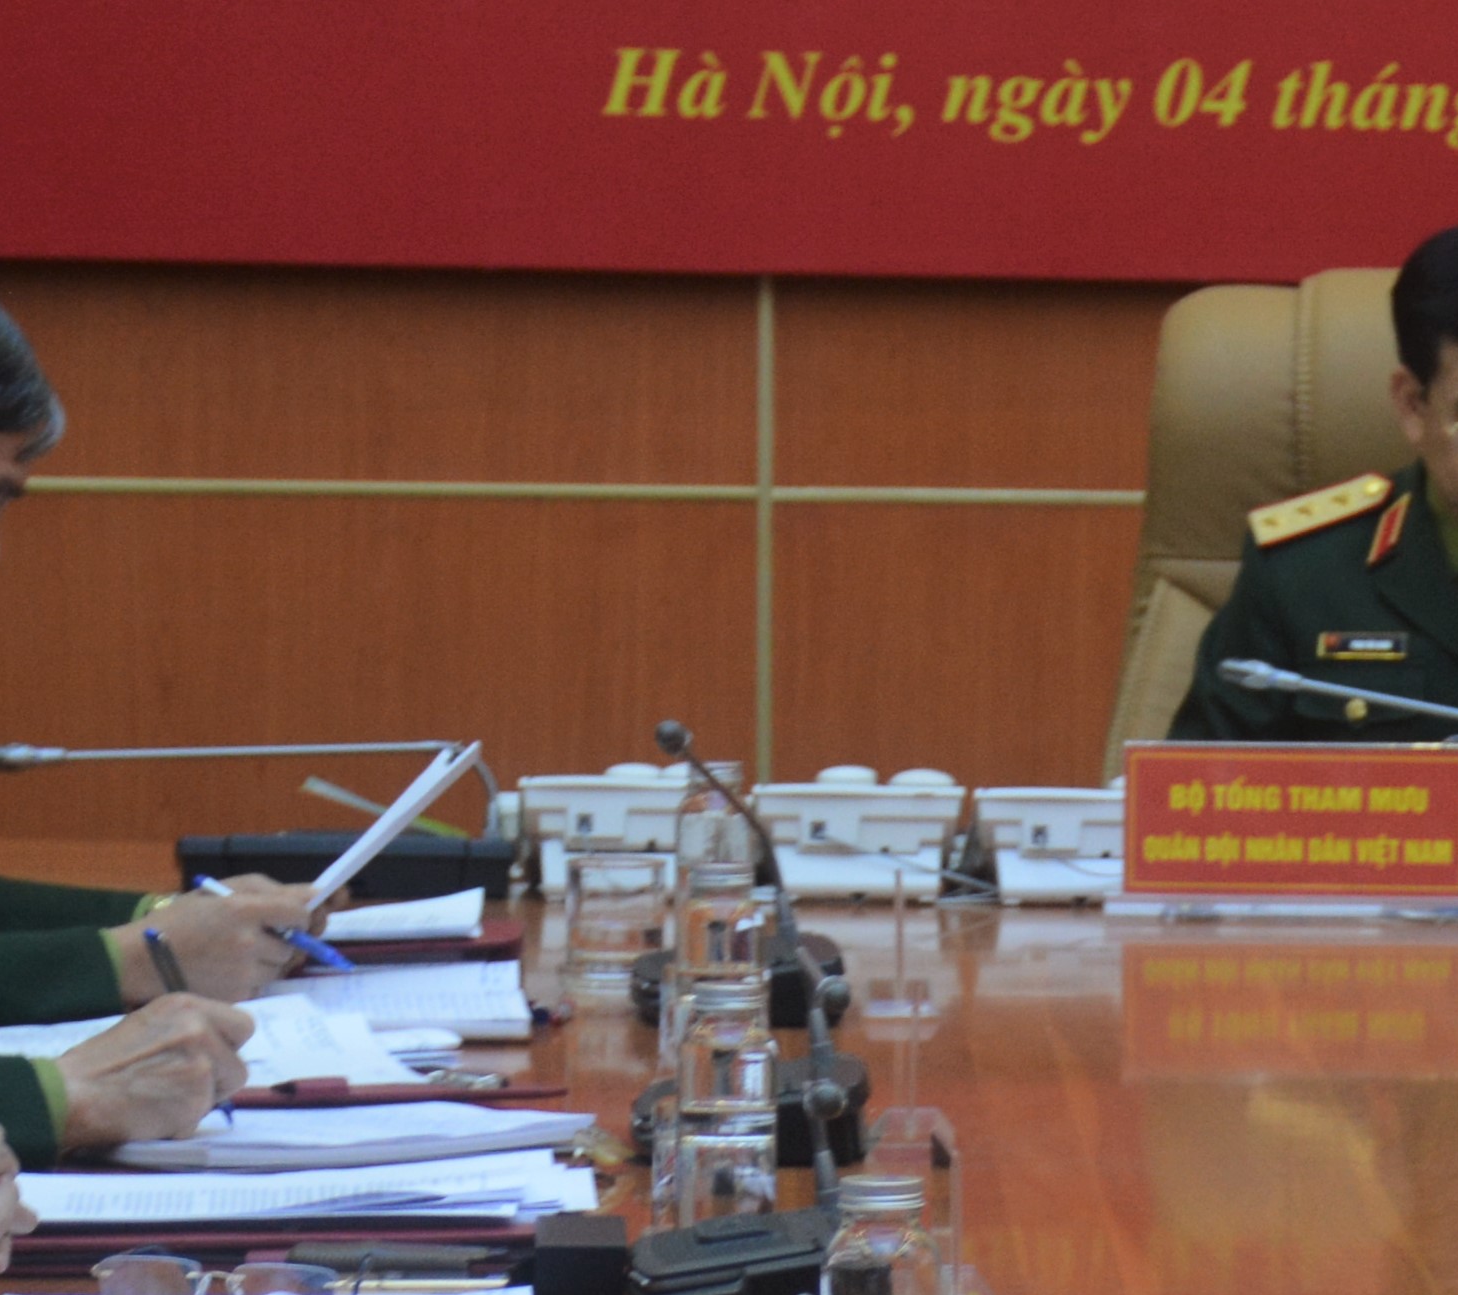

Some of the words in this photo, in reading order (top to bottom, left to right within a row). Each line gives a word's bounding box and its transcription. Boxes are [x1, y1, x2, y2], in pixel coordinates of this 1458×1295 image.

[604, 48, 728, 120] Hà
[748, 51, 917, 136] Nội,
[942, 61, 1130, 146] ngày
[1154, 59, 1252, 129] 04
[1288, 785, 1363, 811] THAM
